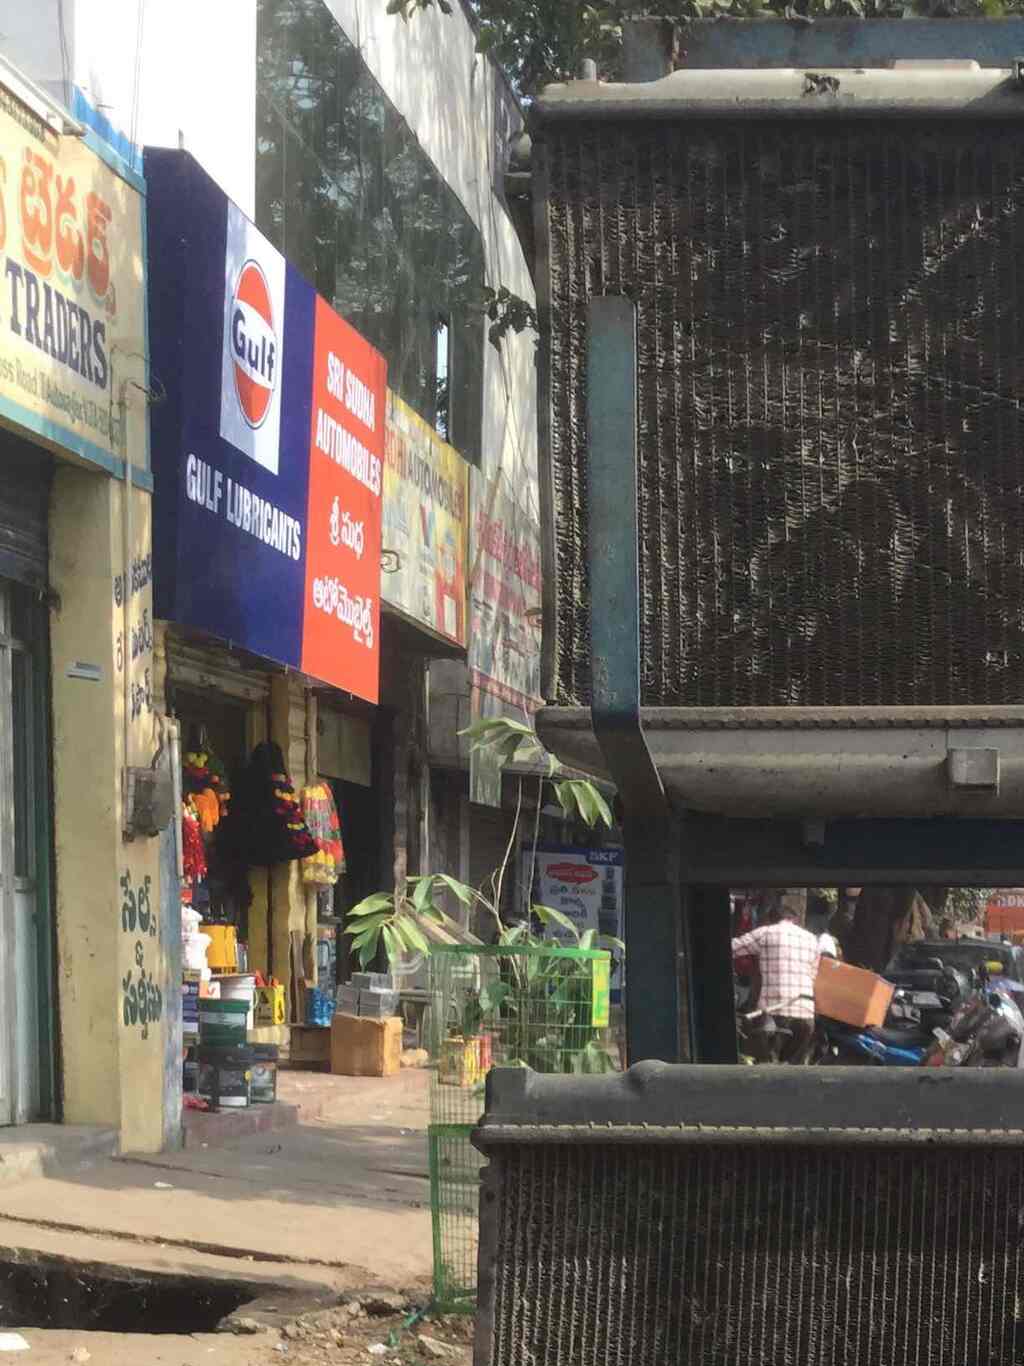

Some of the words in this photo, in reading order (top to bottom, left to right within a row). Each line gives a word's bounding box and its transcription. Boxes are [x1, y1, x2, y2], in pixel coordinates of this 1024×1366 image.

[5, 256, 107, 389] TRADERS
[232, 306, 274, 382] Gulf
[327, 351, 345, 402] SRI
[315, 408, 382, 496] AUTOMOBILES
[186, 453, 224, 514] GULF
[225, 477, 301, 561] LUBRICANTS
